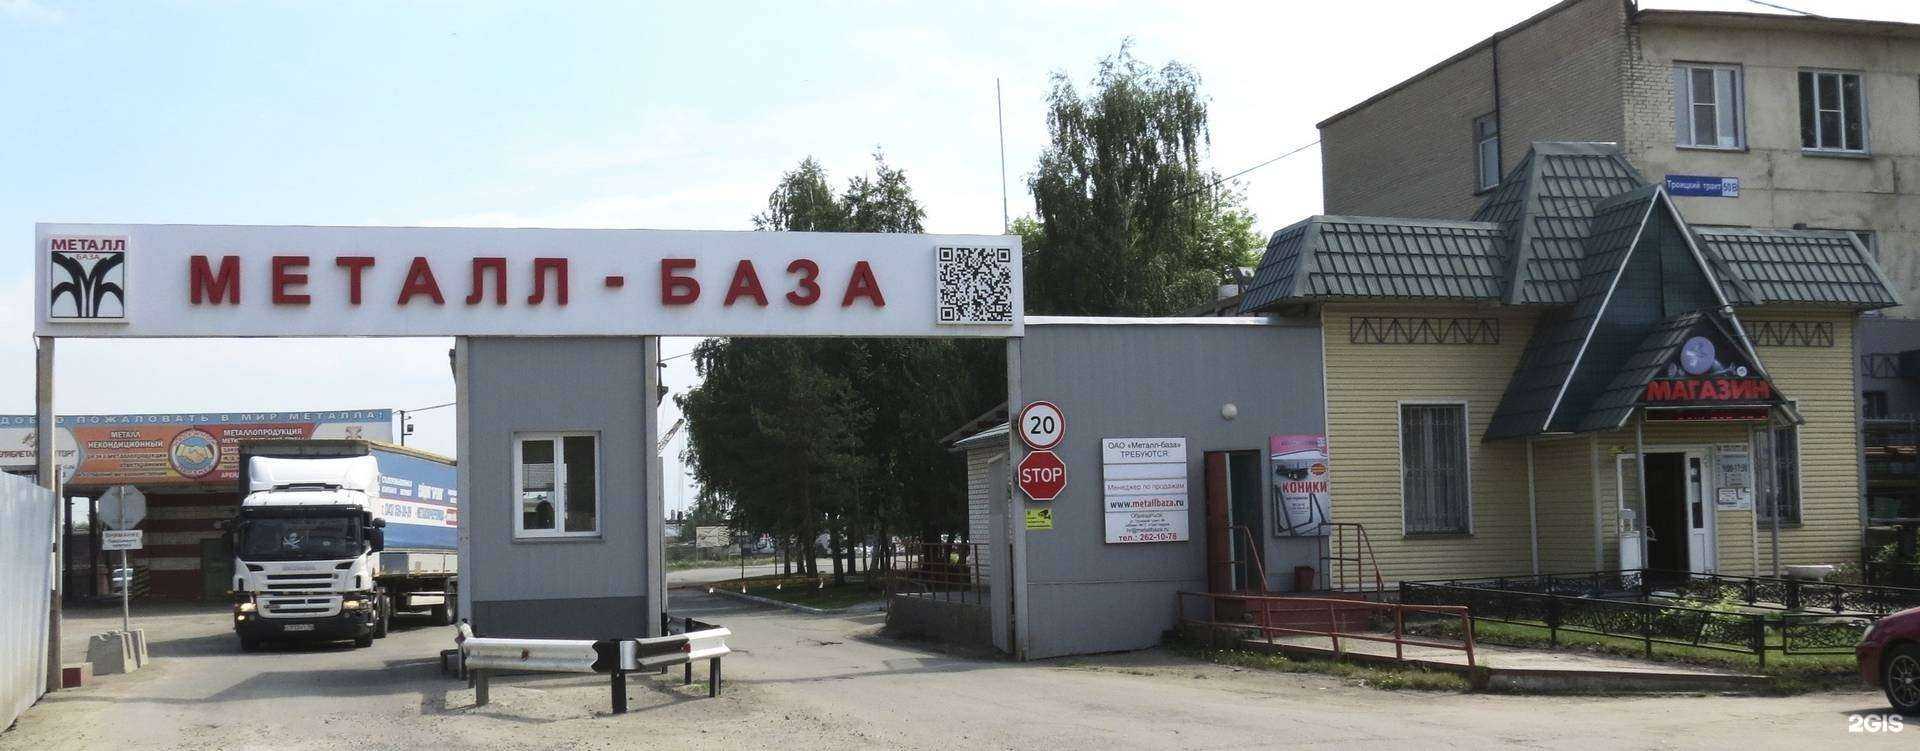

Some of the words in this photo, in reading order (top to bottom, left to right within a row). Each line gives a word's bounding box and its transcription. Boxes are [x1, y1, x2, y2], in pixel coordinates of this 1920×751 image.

[51, 239, 126, 250] МЕТАЛЛ
[190, 255, 569, 306] МЕТАЛЛ
[660, 257, 886, 308] БАЗА
[1646, 379, 1771, 400] МАГАЗИН
[1, 416, 65, 425] ДОБО
[77, 414, 209, 424] ПОЖАЛОВАТЬ
[221, 414, 229, 422] В
[241, 413, 278, 422] МИР
[289, 410, 384, 421] МЕТАЛЛА!
[1030, 416, 1055, 435] 20
[110, 431, 141, 439] МЕТАЛЛ
[223, 428, 303, 437] МЕТАЛЛОПРОДУКЦИЯ
[87, 440, 164, 449] НЕКОНДИЦИОННЫЙ
[1121, 450, 1168, 458] ТРЕБУЮТСЯ
[1022, 467, 1063, 483] STOP
[1282, 481, 1328, 493] КОНИКИ
[1110, 498, 1184, 508] www.metallbaza.ru
[1140, 533, 1177, 541] 262-10-78
